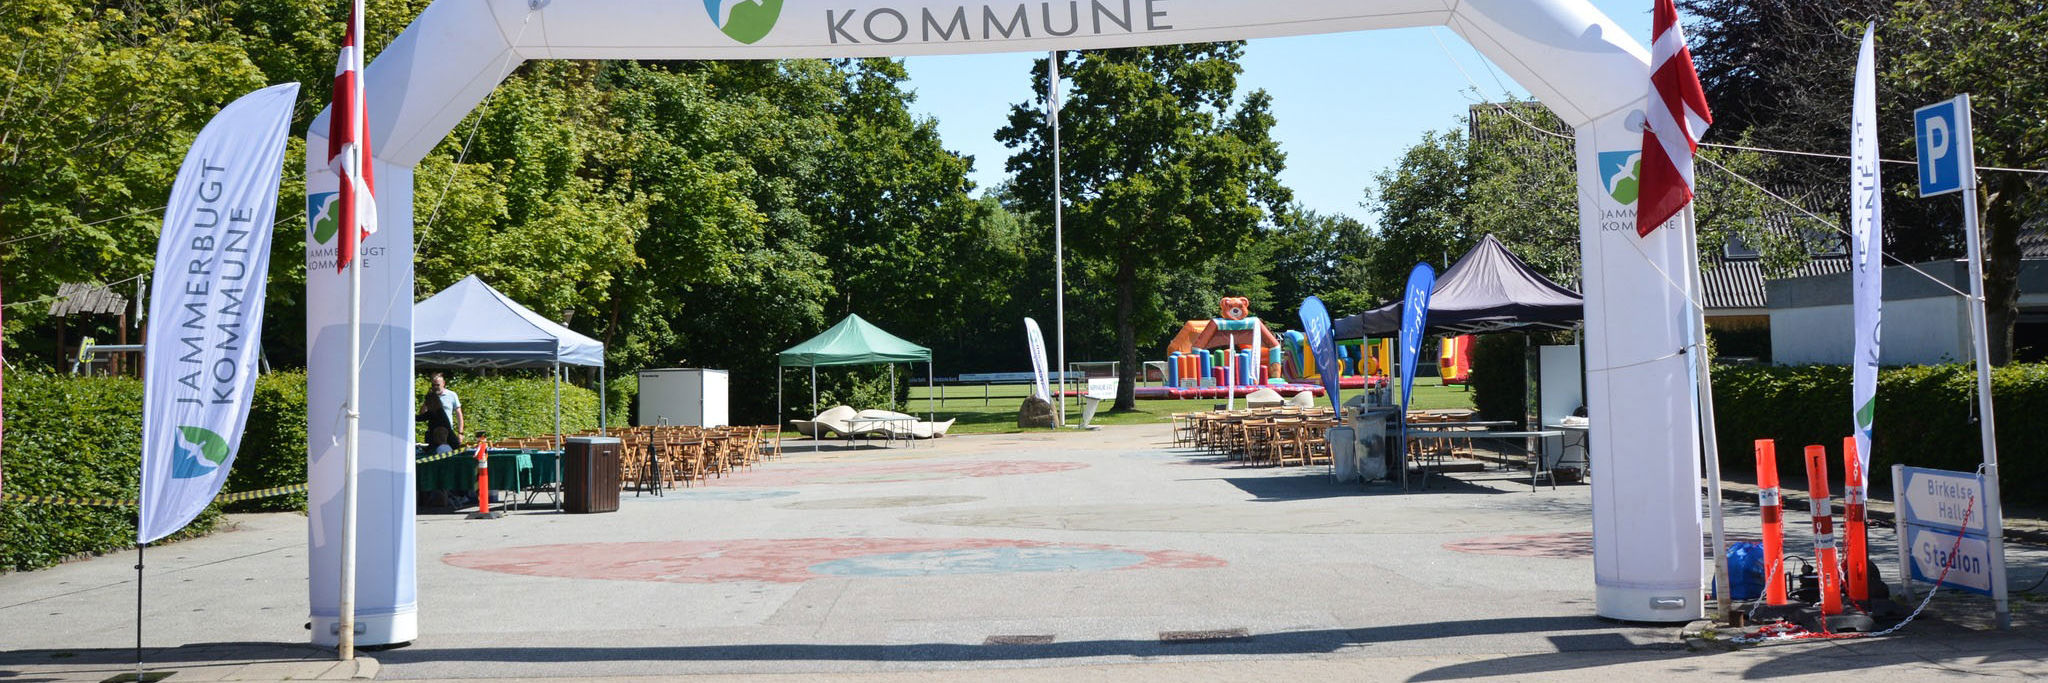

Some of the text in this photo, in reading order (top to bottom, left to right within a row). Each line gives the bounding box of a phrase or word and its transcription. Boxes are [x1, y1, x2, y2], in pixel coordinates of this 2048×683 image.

[826, 0, 1173, 44] KOMMUNE
[1925, 115, 1949, 184] P
[1602, 220, 1676, 231] KOMNE
[176, 158, 225, 407] JAMMERBUGT
[212, 207, 253, 404] KOMMUNE
[1927, 479, 1973, 500] Birkelse
[1939, 502, 1975, 521] Hallen
[1923, 542, 1980, 574] Stadion
